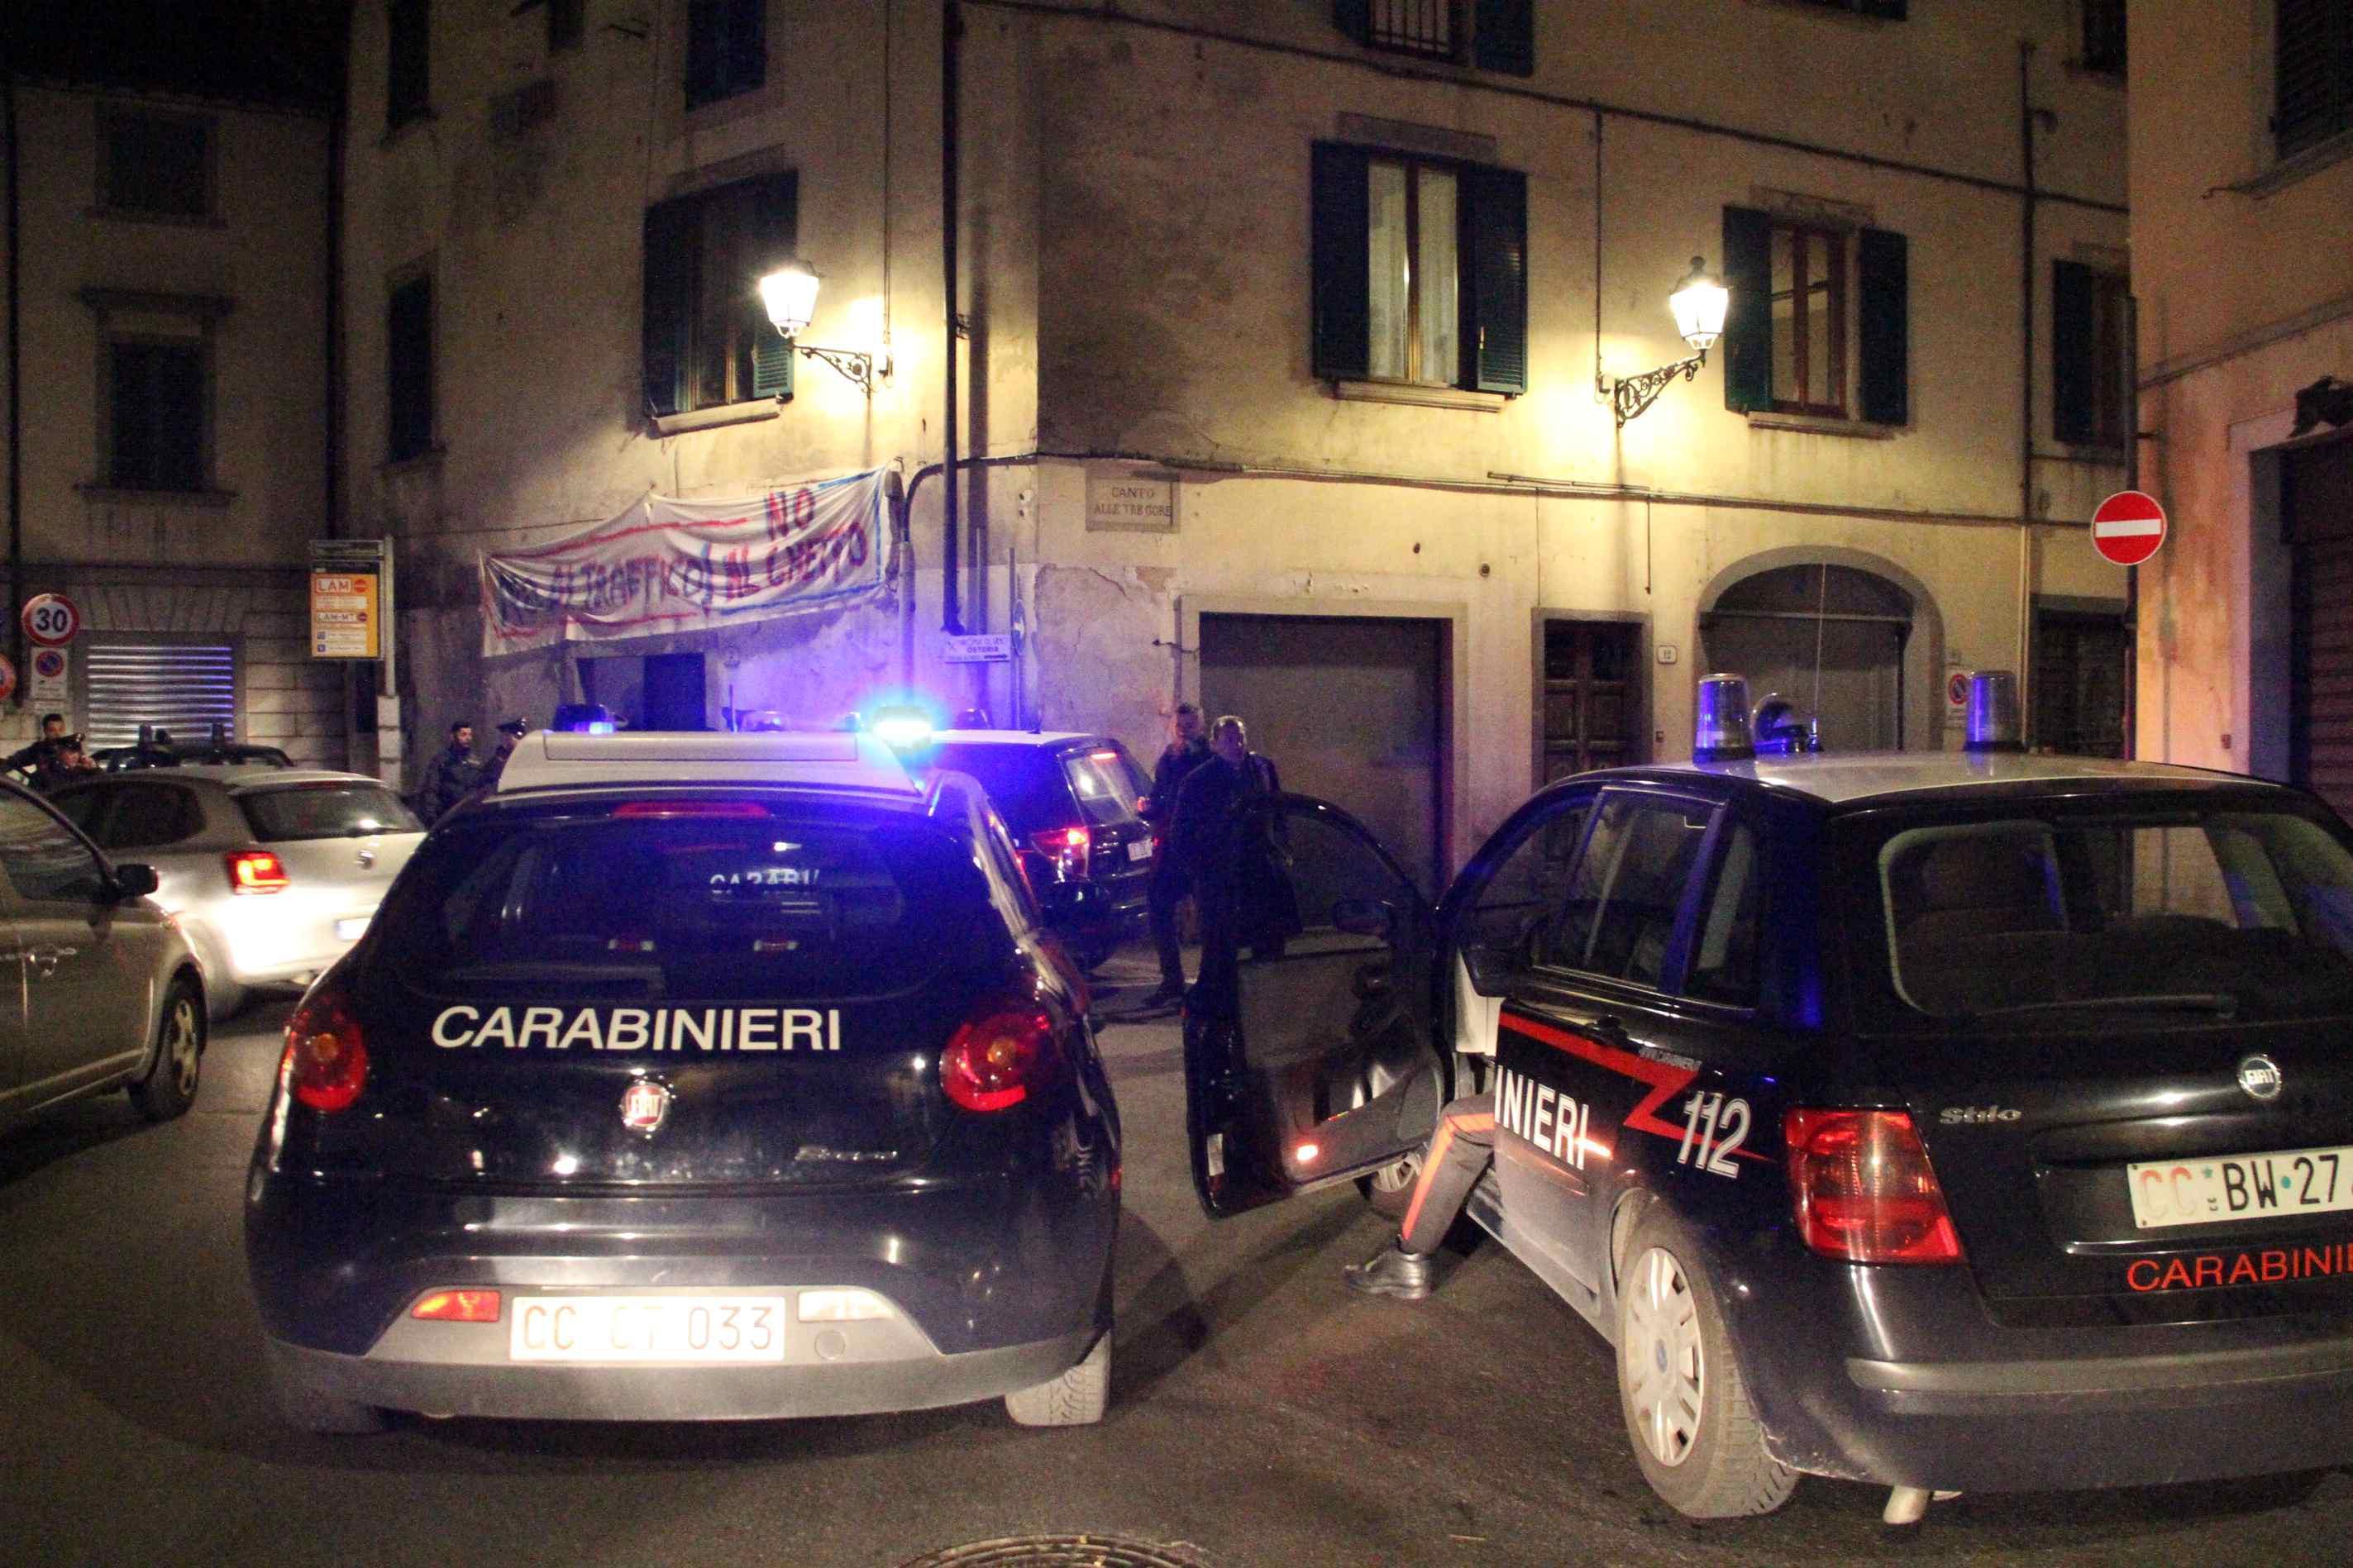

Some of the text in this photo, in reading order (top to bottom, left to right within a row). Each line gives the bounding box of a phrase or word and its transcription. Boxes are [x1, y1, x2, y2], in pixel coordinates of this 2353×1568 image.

[765, 488, 816, 541] NO
[1111, 486, 1155, 498] CANTO
[318, 579, 349, 592] LAM
[36, 608, 68, 632] 30
[431, 1003, 842, 1051] CARABINIERI
[2244, 1068, 2275, 1085] FIAT
[1677, 1090, 1752, 1179] 112
[2138, 1153, 2340, 1219] CC BW 27
[2126, 1242, 2353, 1293] CARABINI
[523, 1304, 576, 1351] CC
[686, 1306, 773, 1351] 033
